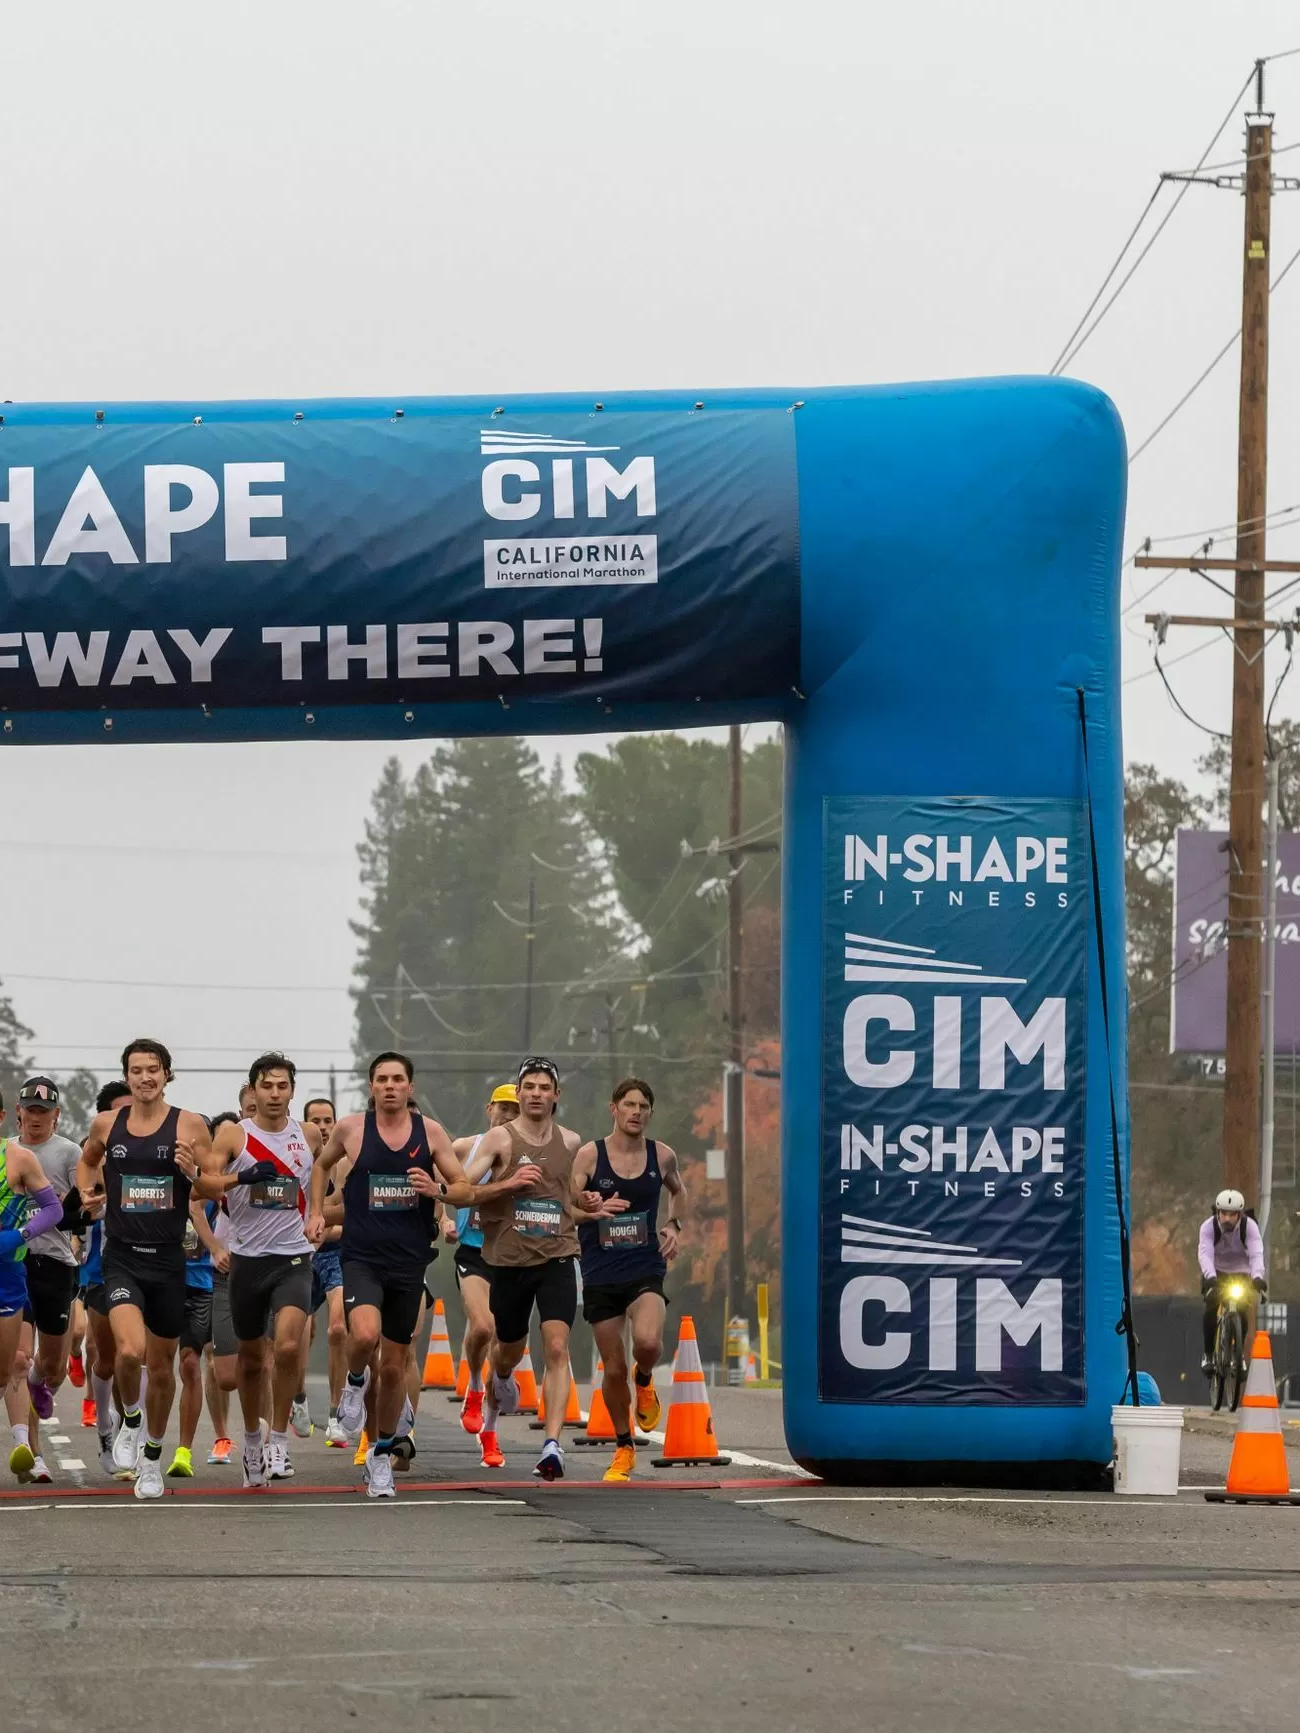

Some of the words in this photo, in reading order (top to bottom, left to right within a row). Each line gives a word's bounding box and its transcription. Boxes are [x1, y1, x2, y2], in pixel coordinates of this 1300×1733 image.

[481, 456, 657, 521] CIM
[497, 544, 645, 566] CALIFORNIA
[497, 568, 580, 581] International
[583, 566, 645, 579] Marathon
[262, 618, 603, 680] THERE!
[844, 833, 1068, 883] IN-SHAPE
[843, 889, 1068, 908] FITNESS
[843, 993, 1066, 1090] CIM
[841, 1123, 1065, 1173] IN-SHAPE
[129, 1188, 165, 1199] ROBERTS
[373, 1187, 416, 1198] RANDAZZO
[840, 1179, 1064, 1197] FITNESS
[514, 1210, 560, 1224] SCHNEIDERMAN
[609, 1225, 637, 1236] HOUGH
[839, 1275, 1063, 1371] CIM
